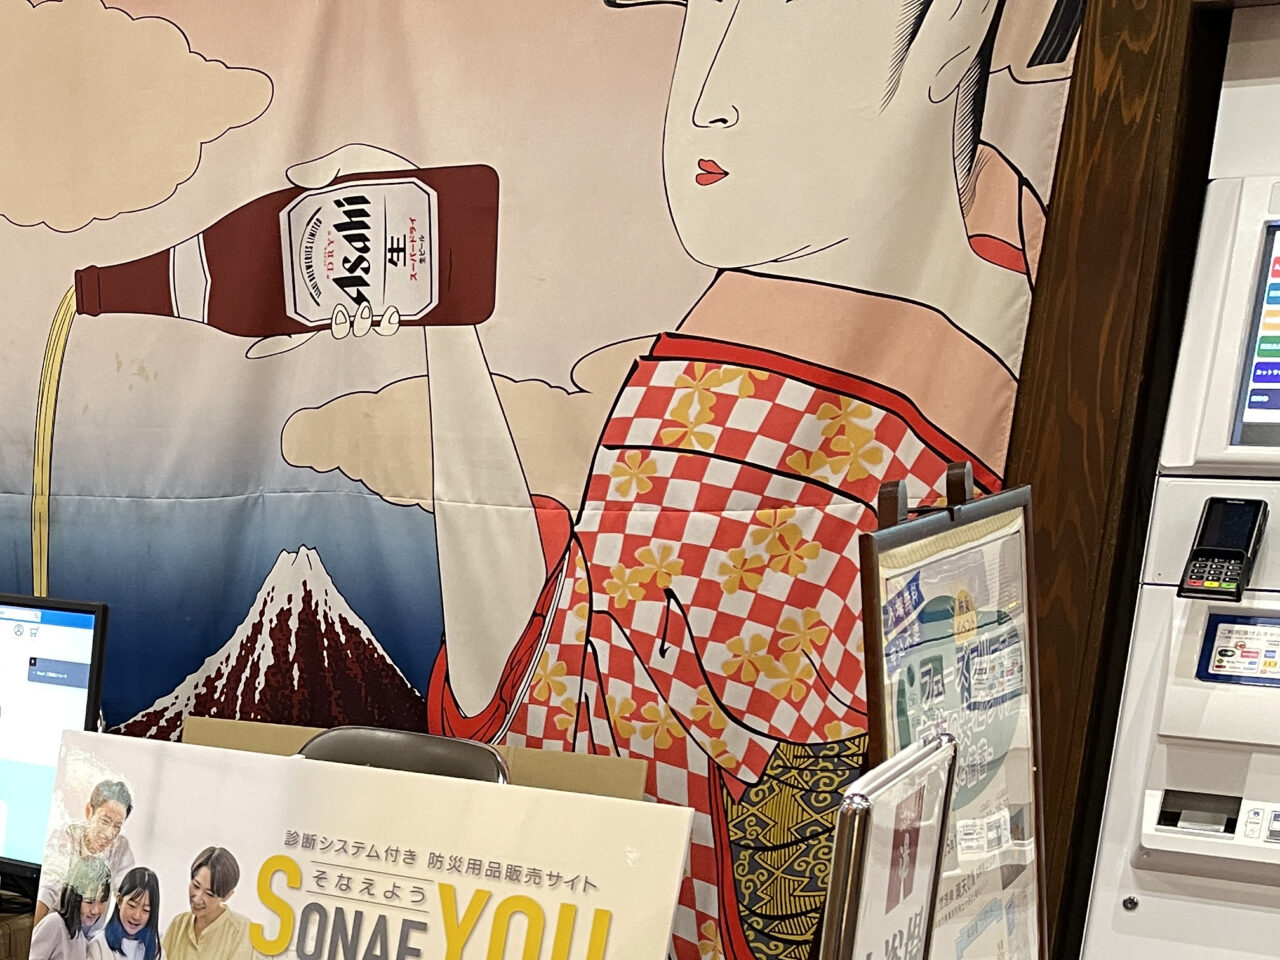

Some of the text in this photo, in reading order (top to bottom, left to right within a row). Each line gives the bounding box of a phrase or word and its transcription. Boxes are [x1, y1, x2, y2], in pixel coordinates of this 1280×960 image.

[332, 195, 372, 308] Asahi
[387, 234, 407, 267] 生
[409, 217, 418, 281] スーパードライ
[418, 234, 426, 265] 生ビール
[284, 830, 599, 893] 診断システム付き 防災用品販売サイト
[312, 869, 427, 905] そなえよう
